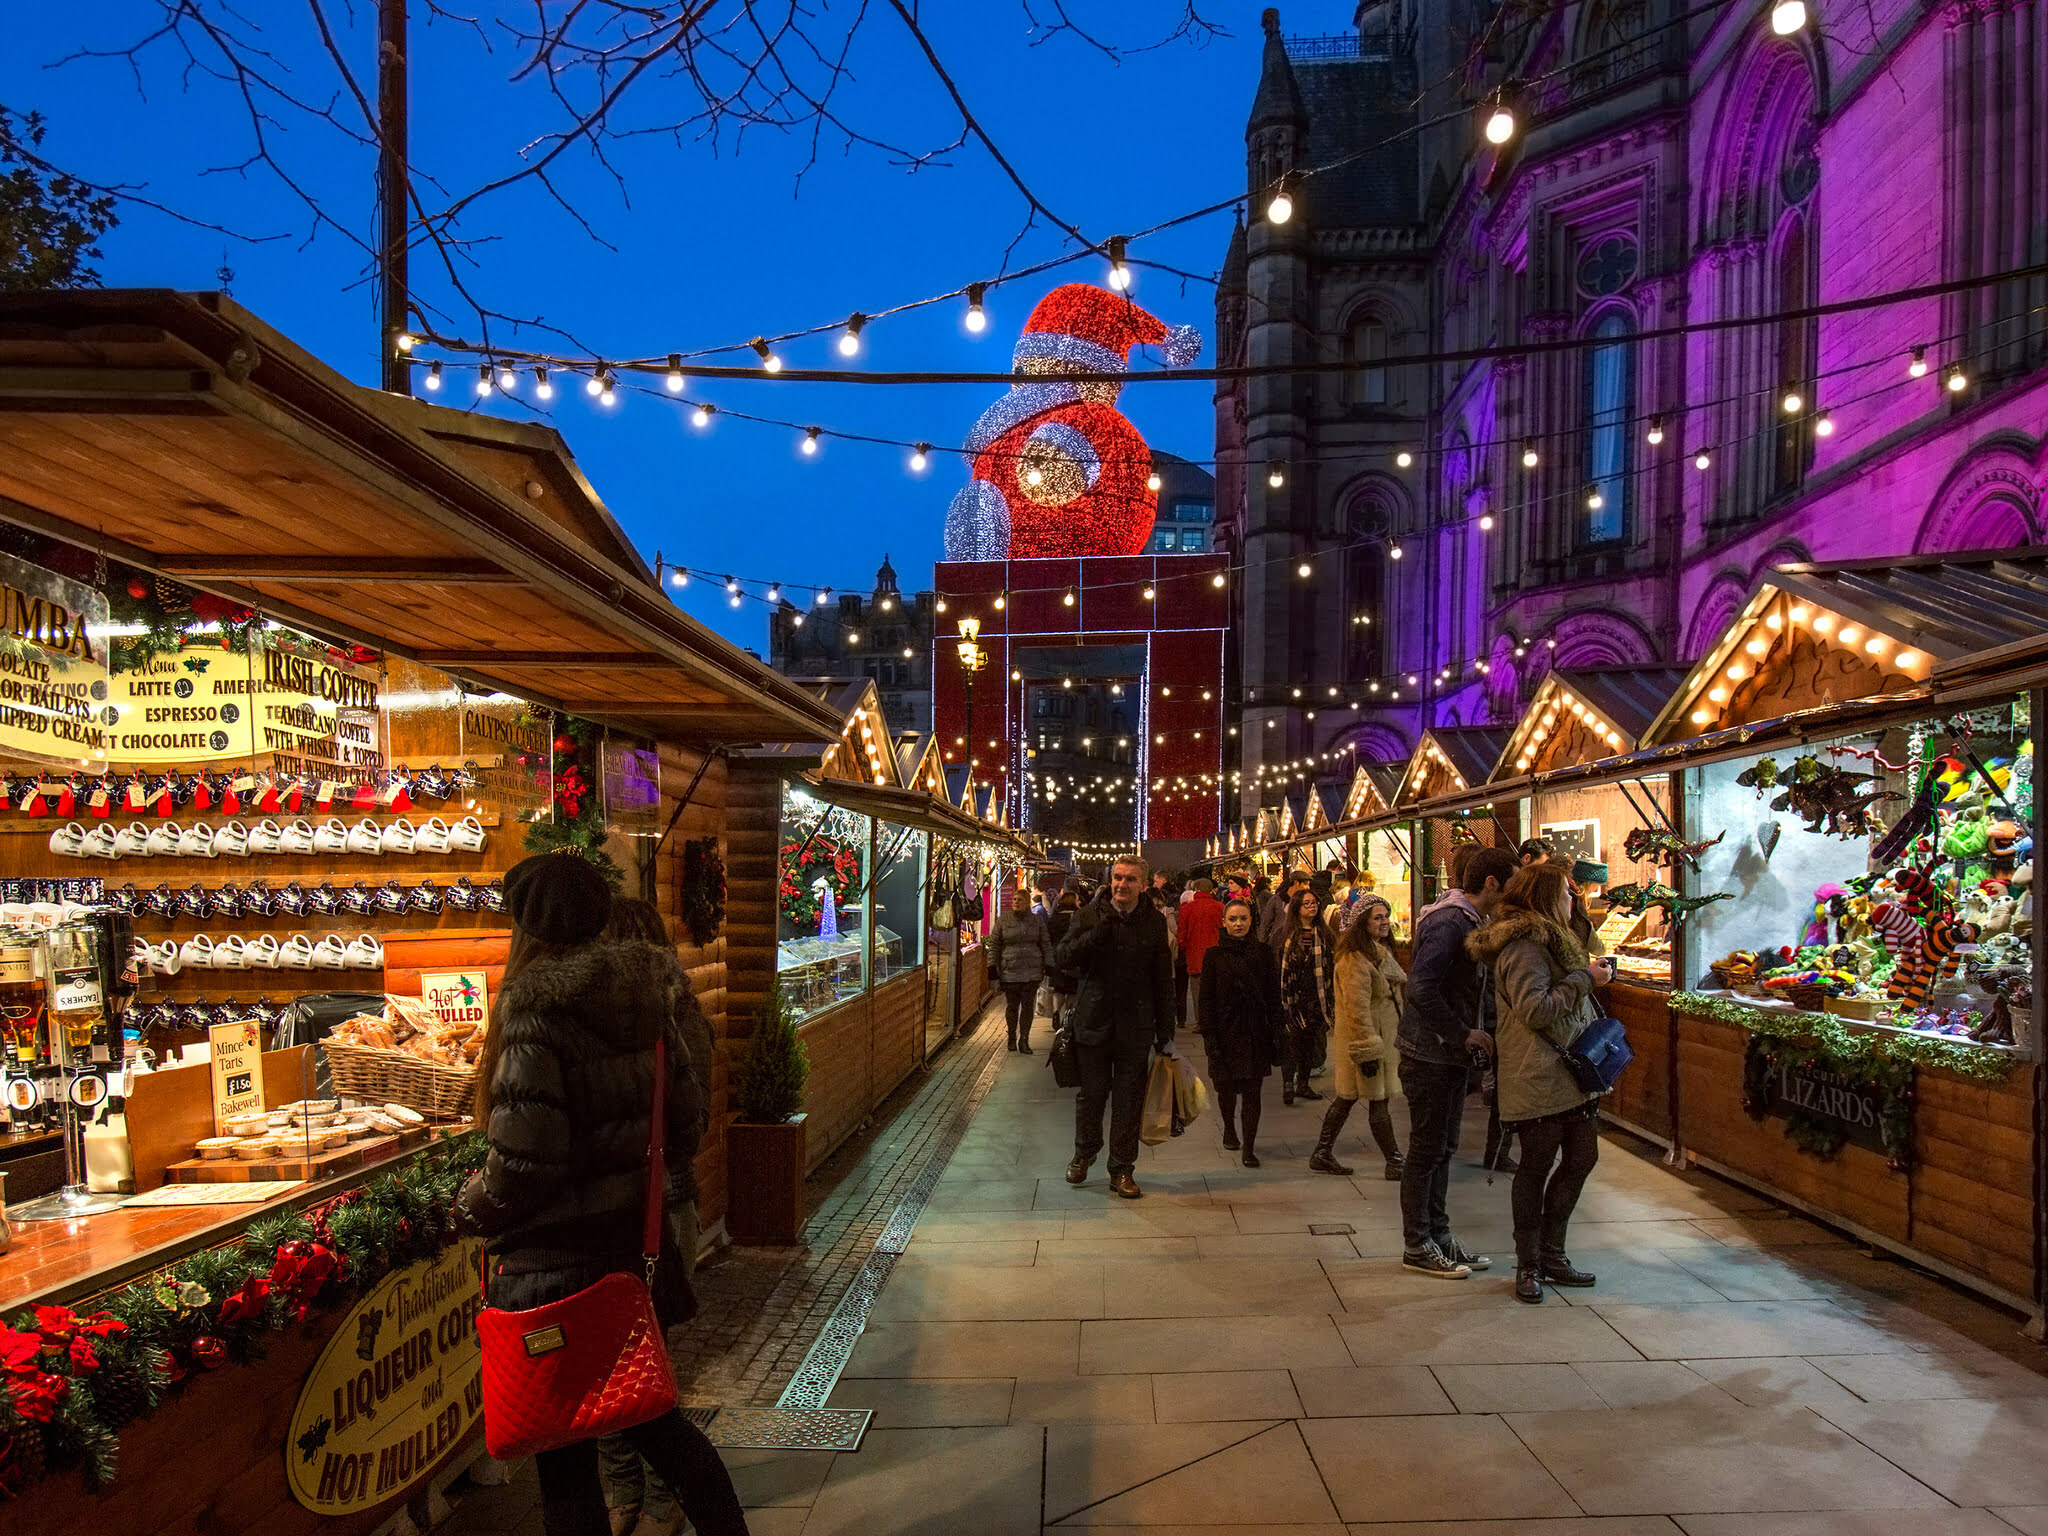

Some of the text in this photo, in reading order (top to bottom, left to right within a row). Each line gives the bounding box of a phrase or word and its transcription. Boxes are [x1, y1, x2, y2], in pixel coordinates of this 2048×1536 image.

[132, 660, 177, 676] Menu
[129, 681, 172, 696] LATTE
[264, 648, 315, 696] IRISH
[320, 666, 379, 713] COFFEE
[29, 685, 90, 719] BAILEYS
[145, 706, 218, 722] ESPRESSO
[280, 705, 336, 736] AMERICANO
[339, 720, 370, 744] COFFEE
[52, 718, 104, 749] CREAM
[121, 733, 207, 749] CHOCOLATE
[466, 709, 550, 755] CALYPSO COFFEE
[264, 727, 384, 768] WITH WHISKEY & TOPPED
[273, 754, 379, 787] WITH WHIPPED CREAM
[7, 883, 19, 894] 15
[68, 881, 80, 892] 15
[40, 914, 53, 928] 15
[60, 991, 101, 1006] TEACHER'S
[429, 987, 461, 1008] Hot
[216, 1041, 244, 1056] Mince
[219, 1057, 243, 1071] Tarts
[228, 1079, 251, 1096] £1.50
[1780, 1064, 1874, 1128] LIZARDS
[220, 1094, 260, 1116] Bakewell
[333, 1328, 433, 1437] LIQUEUR
[437, 1292, 482, 1355] COFF
[422, 1364, 445, 1411] and
[316, 1401, 462, 1505] HOT MULLED
